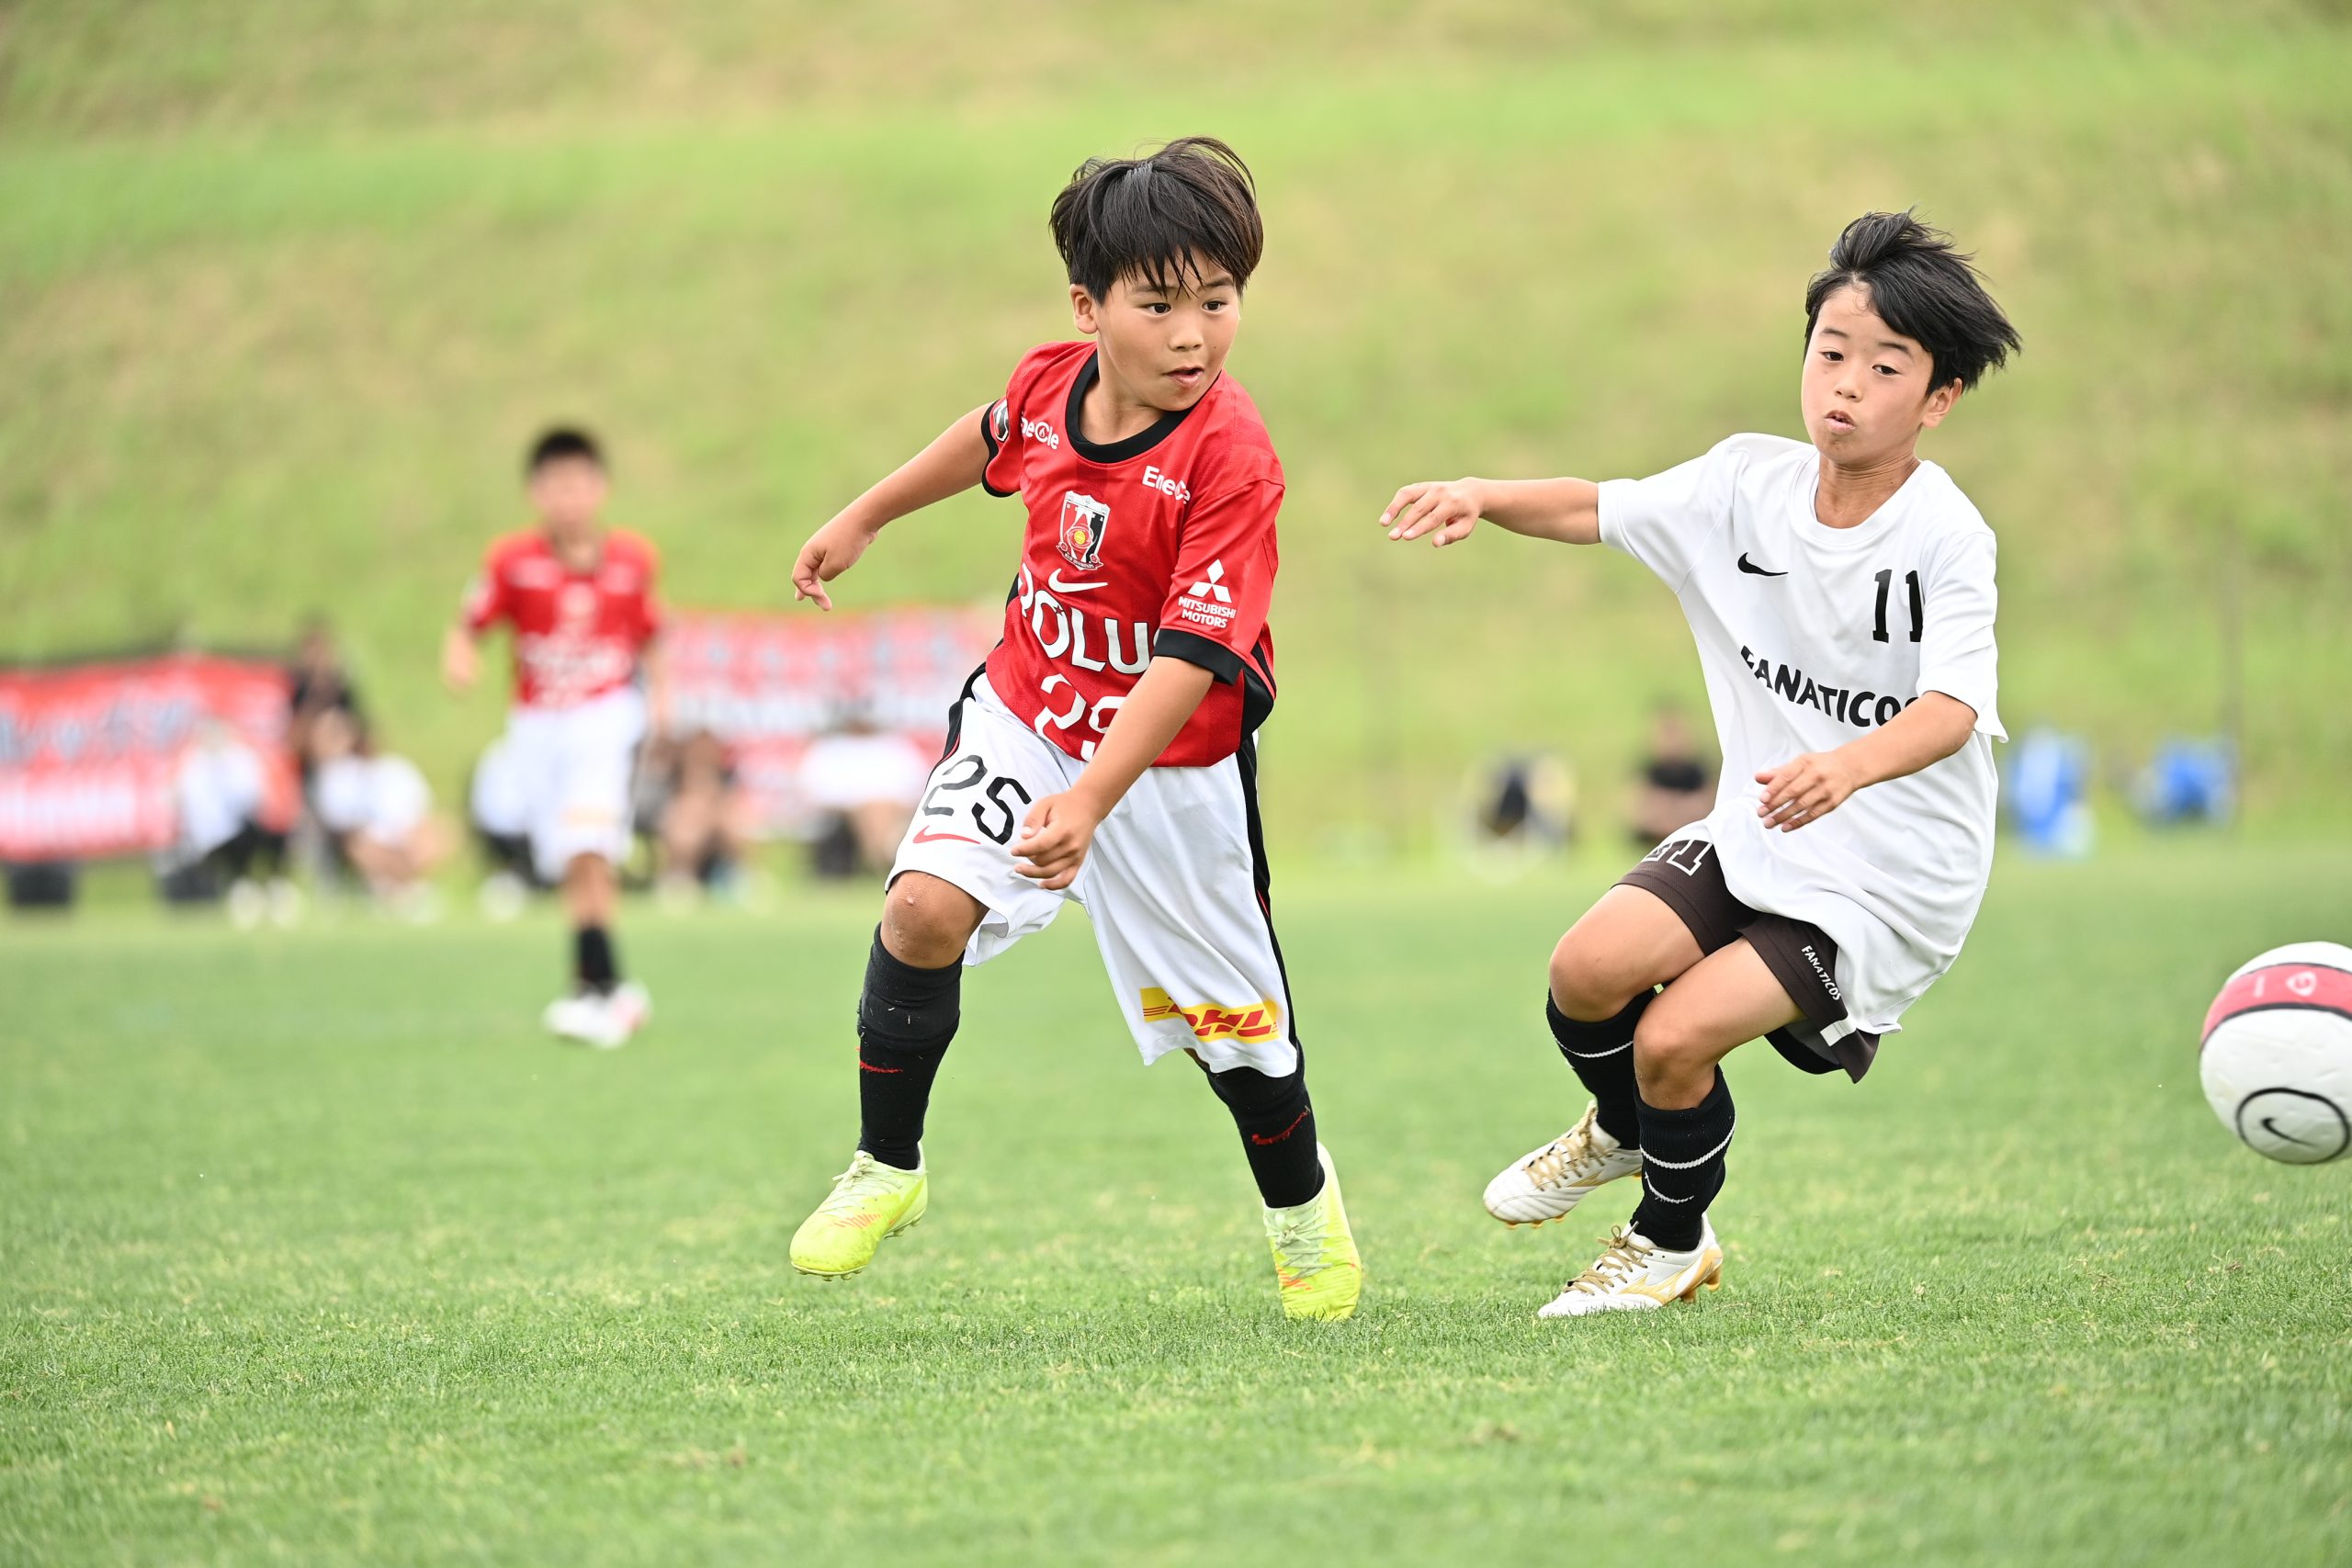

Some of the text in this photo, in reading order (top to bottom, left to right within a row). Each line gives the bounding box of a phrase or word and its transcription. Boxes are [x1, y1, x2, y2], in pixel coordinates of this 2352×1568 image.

[1021, 410, 1059, 450] neCle
[1178, 596, 1237, 619] MITSUBISHI
[1182, 609, 1227, 628] MOTORS
[1872, 569, 1924, 643] 11
[1740, 645, 1919, 728] FANATICO
[922, 754, 1032, 845] 25
[1802, 945, 1842, 1000] FANATICOS
[1167, 996, 1272, 1037] DHL
